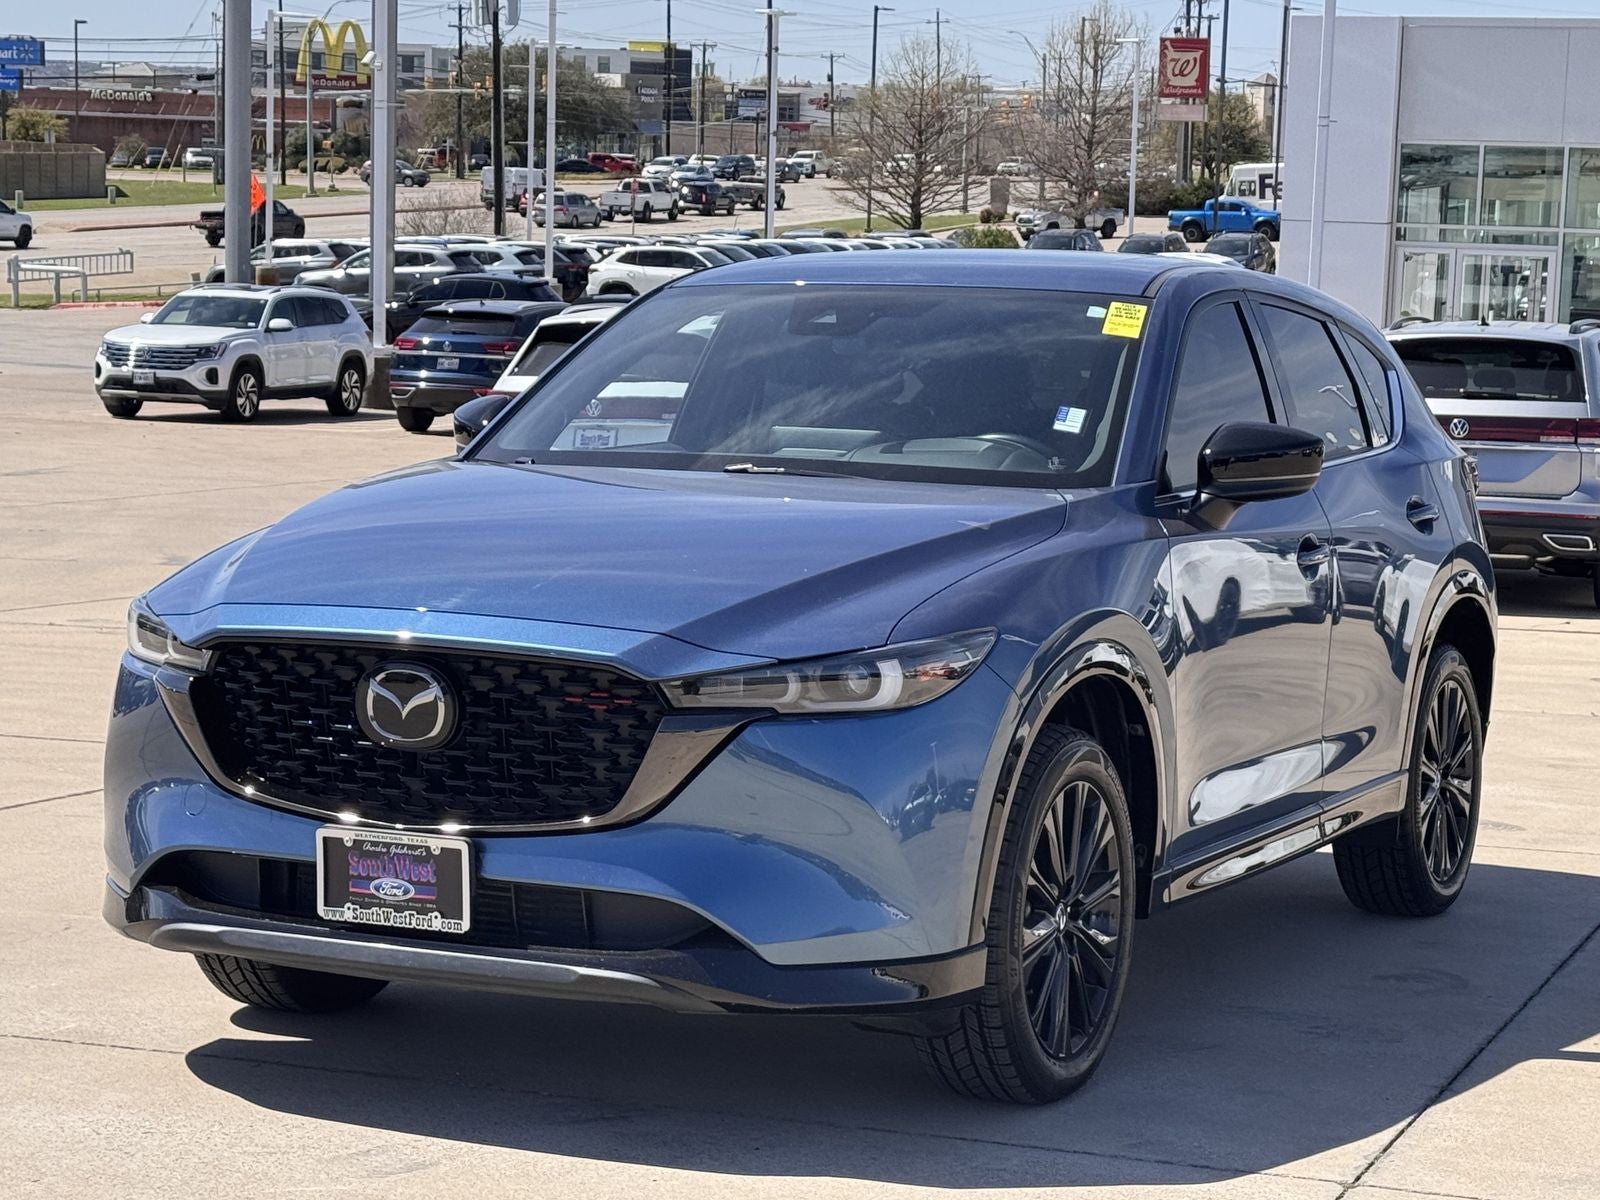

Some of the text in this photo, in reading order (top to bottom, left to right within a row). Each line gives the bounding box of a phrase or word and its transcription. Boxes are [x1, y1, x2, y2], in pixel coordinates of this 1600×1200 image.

[90, 88, 153, 102] McDonald's
[1163, 86, 1202, 96] Walgreens
[348, 851, 437, 883] SouthWest
[379, 881, 405, 896] Ford
[323, 907, 463, 932] www.SouthWestFord.com
